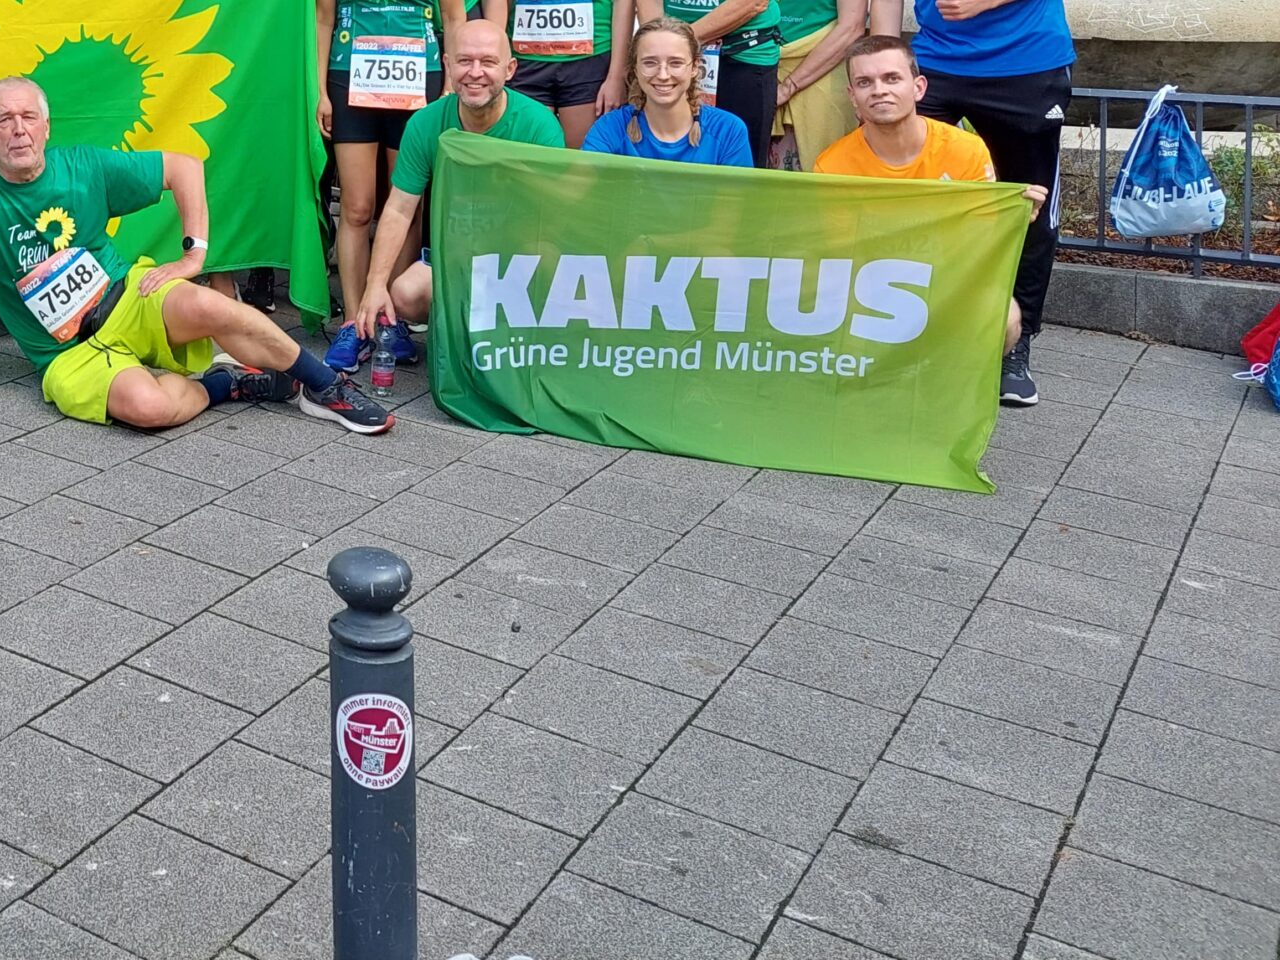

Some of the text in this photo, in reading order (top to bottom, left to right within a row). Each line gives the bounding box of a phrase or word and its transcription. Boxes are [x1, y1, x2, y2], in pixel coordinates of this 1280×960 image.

[517, 8, 584, 29] A 7560 3
[392, 43, 424, 53] STAFFEL
[353, 59, 423, 82] A 7556 1
[707, 70, 714, 80] 4
[8, 224, 37, 244] Team
[18, 241, 49, 272] GRÜN
[38, 263, 99, 321] A 7548 4
[470, 253, 933, 344] KAKTUS
[472, 337, 875, 377] Grüne Jugend Münster
[343, 757, 364, 781] ohne
